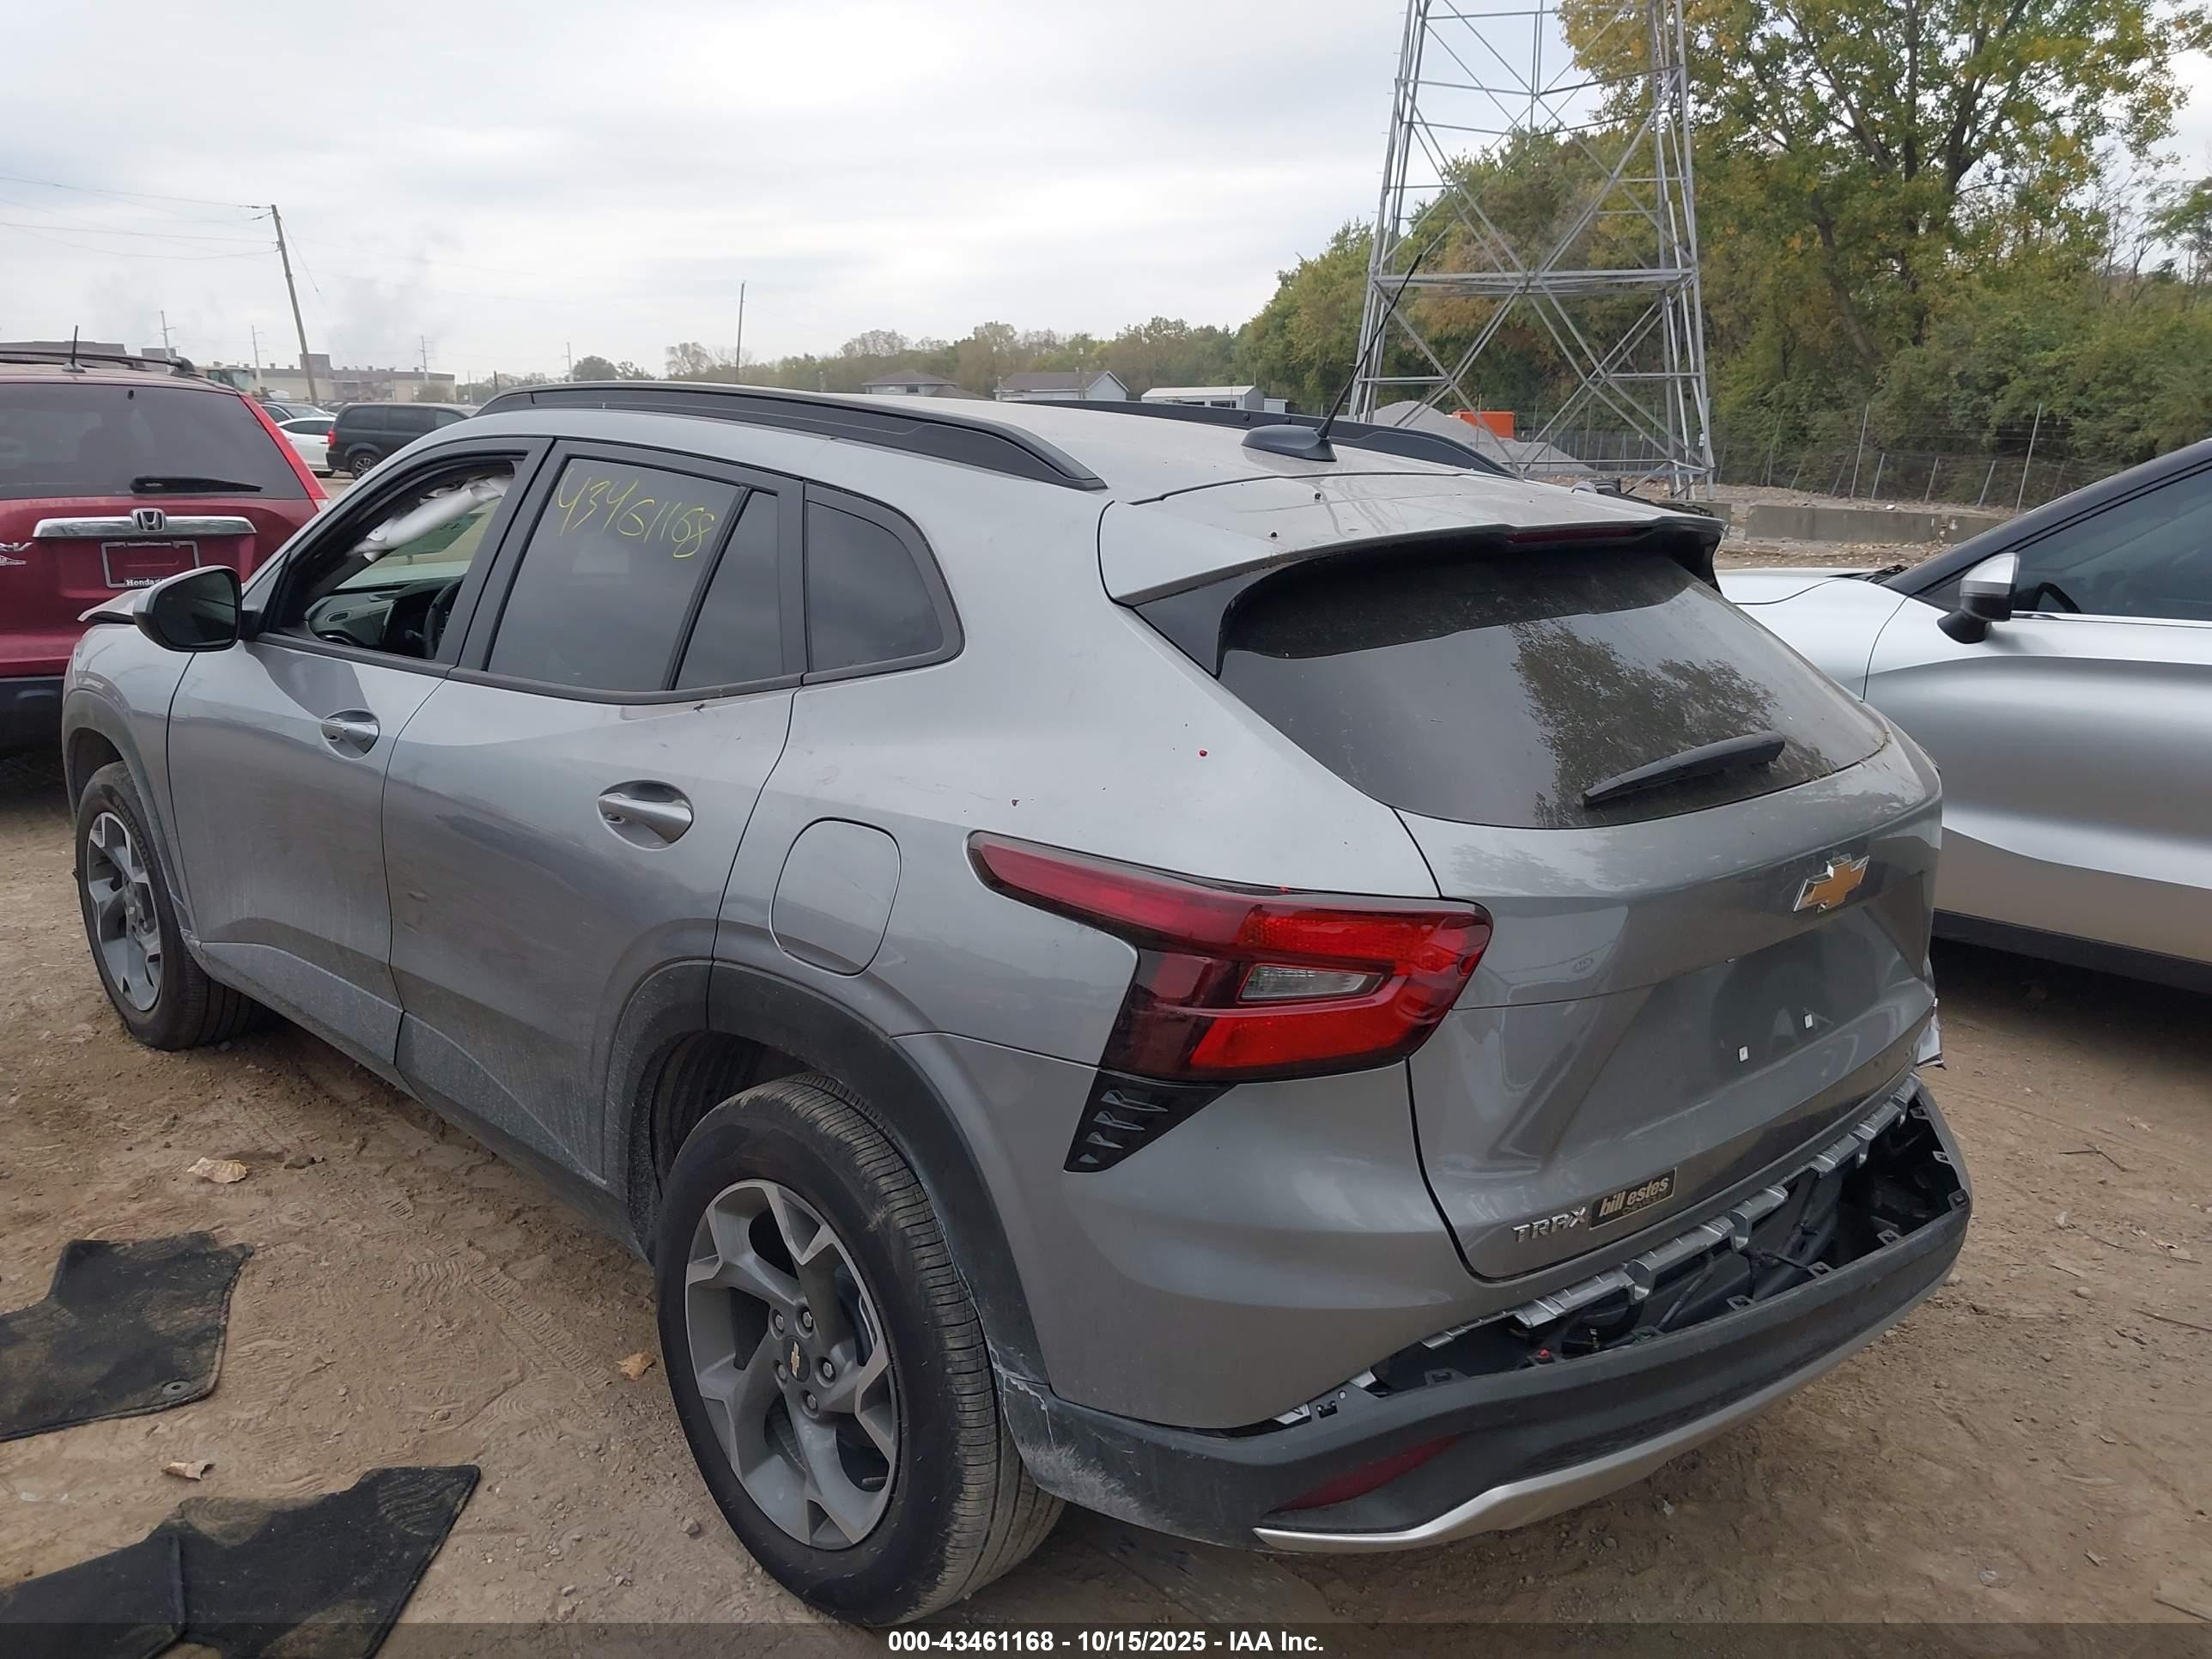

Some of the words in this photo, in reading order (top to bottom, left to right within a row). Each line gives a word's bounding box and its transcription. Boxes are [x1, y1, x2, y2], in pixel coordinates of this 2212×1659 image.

[558, 467, 715, 558] 43461168
[1599, 1191, 1626, 1217] bill
[1626, 1177, 1669, 1206] estes
[1511, 1206, 1586, 1243] TRAX
